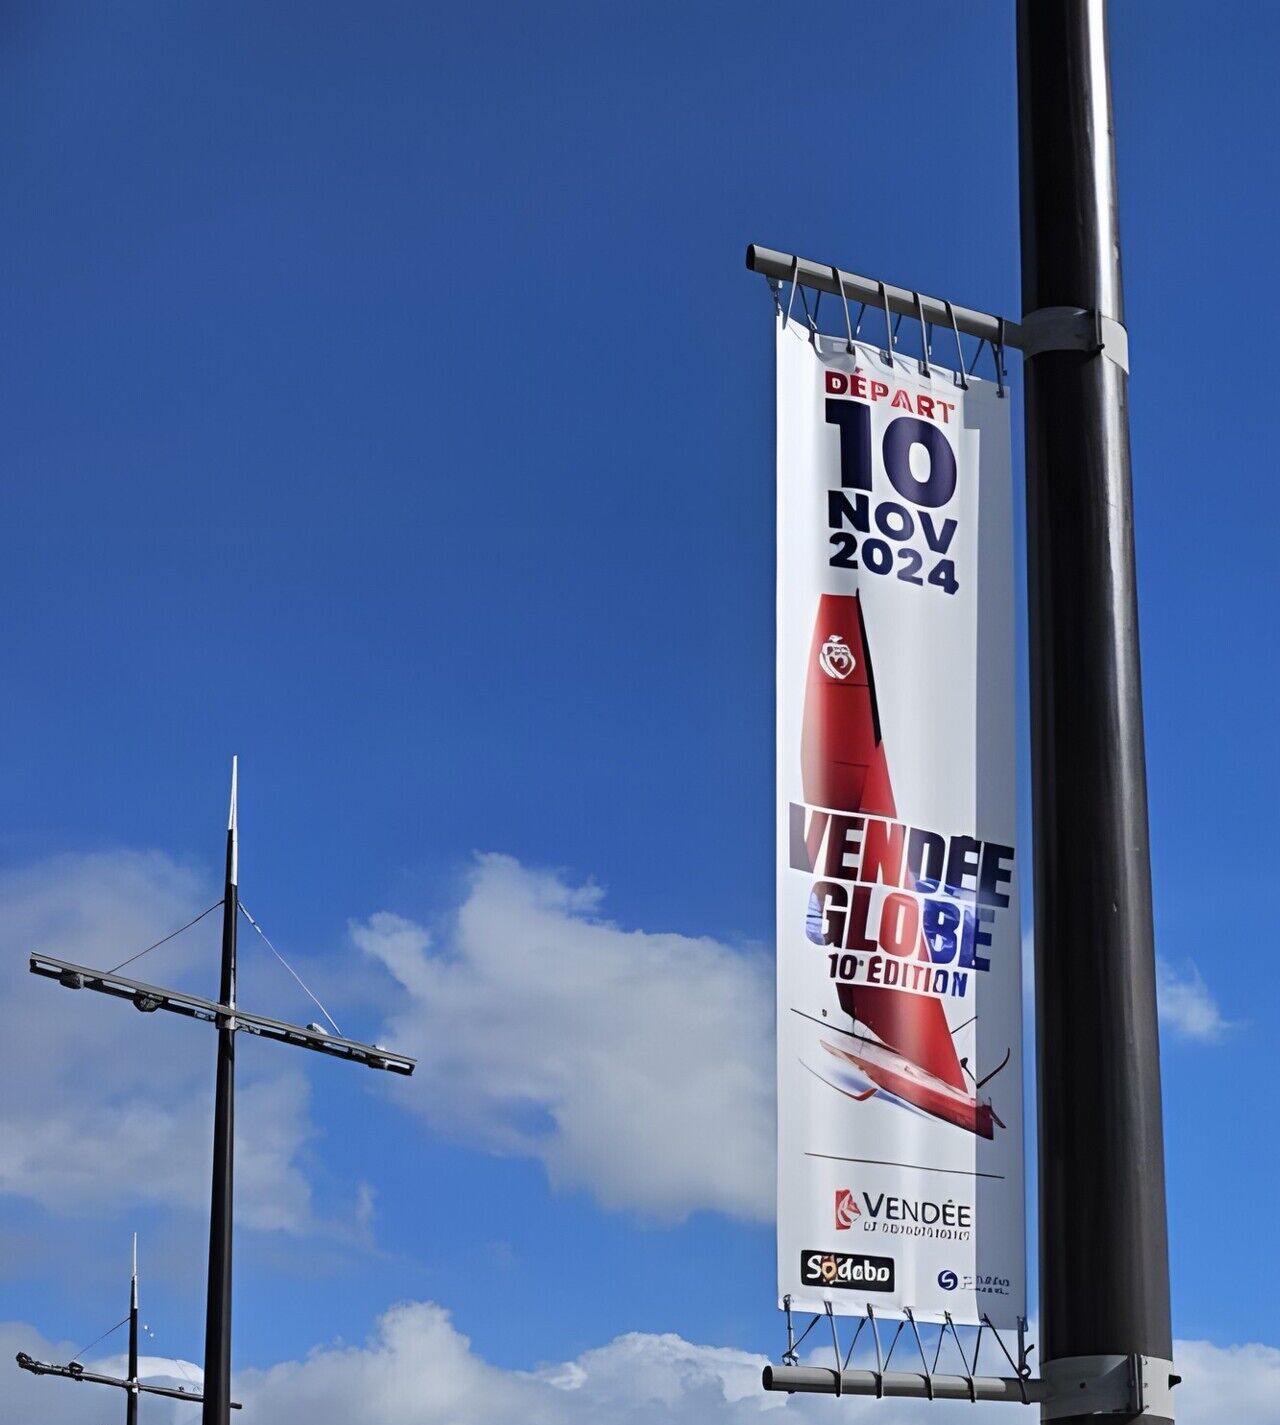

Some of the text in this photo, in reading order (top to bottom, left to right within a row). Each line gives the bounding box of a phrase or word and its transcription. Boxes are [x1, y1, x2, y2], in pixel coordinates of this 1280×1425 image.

[825, 366, 955, 424] DÉPART
[825, 397, 958, 508] 10
[828, 490, 958, 555] NOV
[828, 532, 960, 595] 2024
[805, 880, 995, 972] GLOBE
[862, 1191, 971, 1228] VENDÉE
